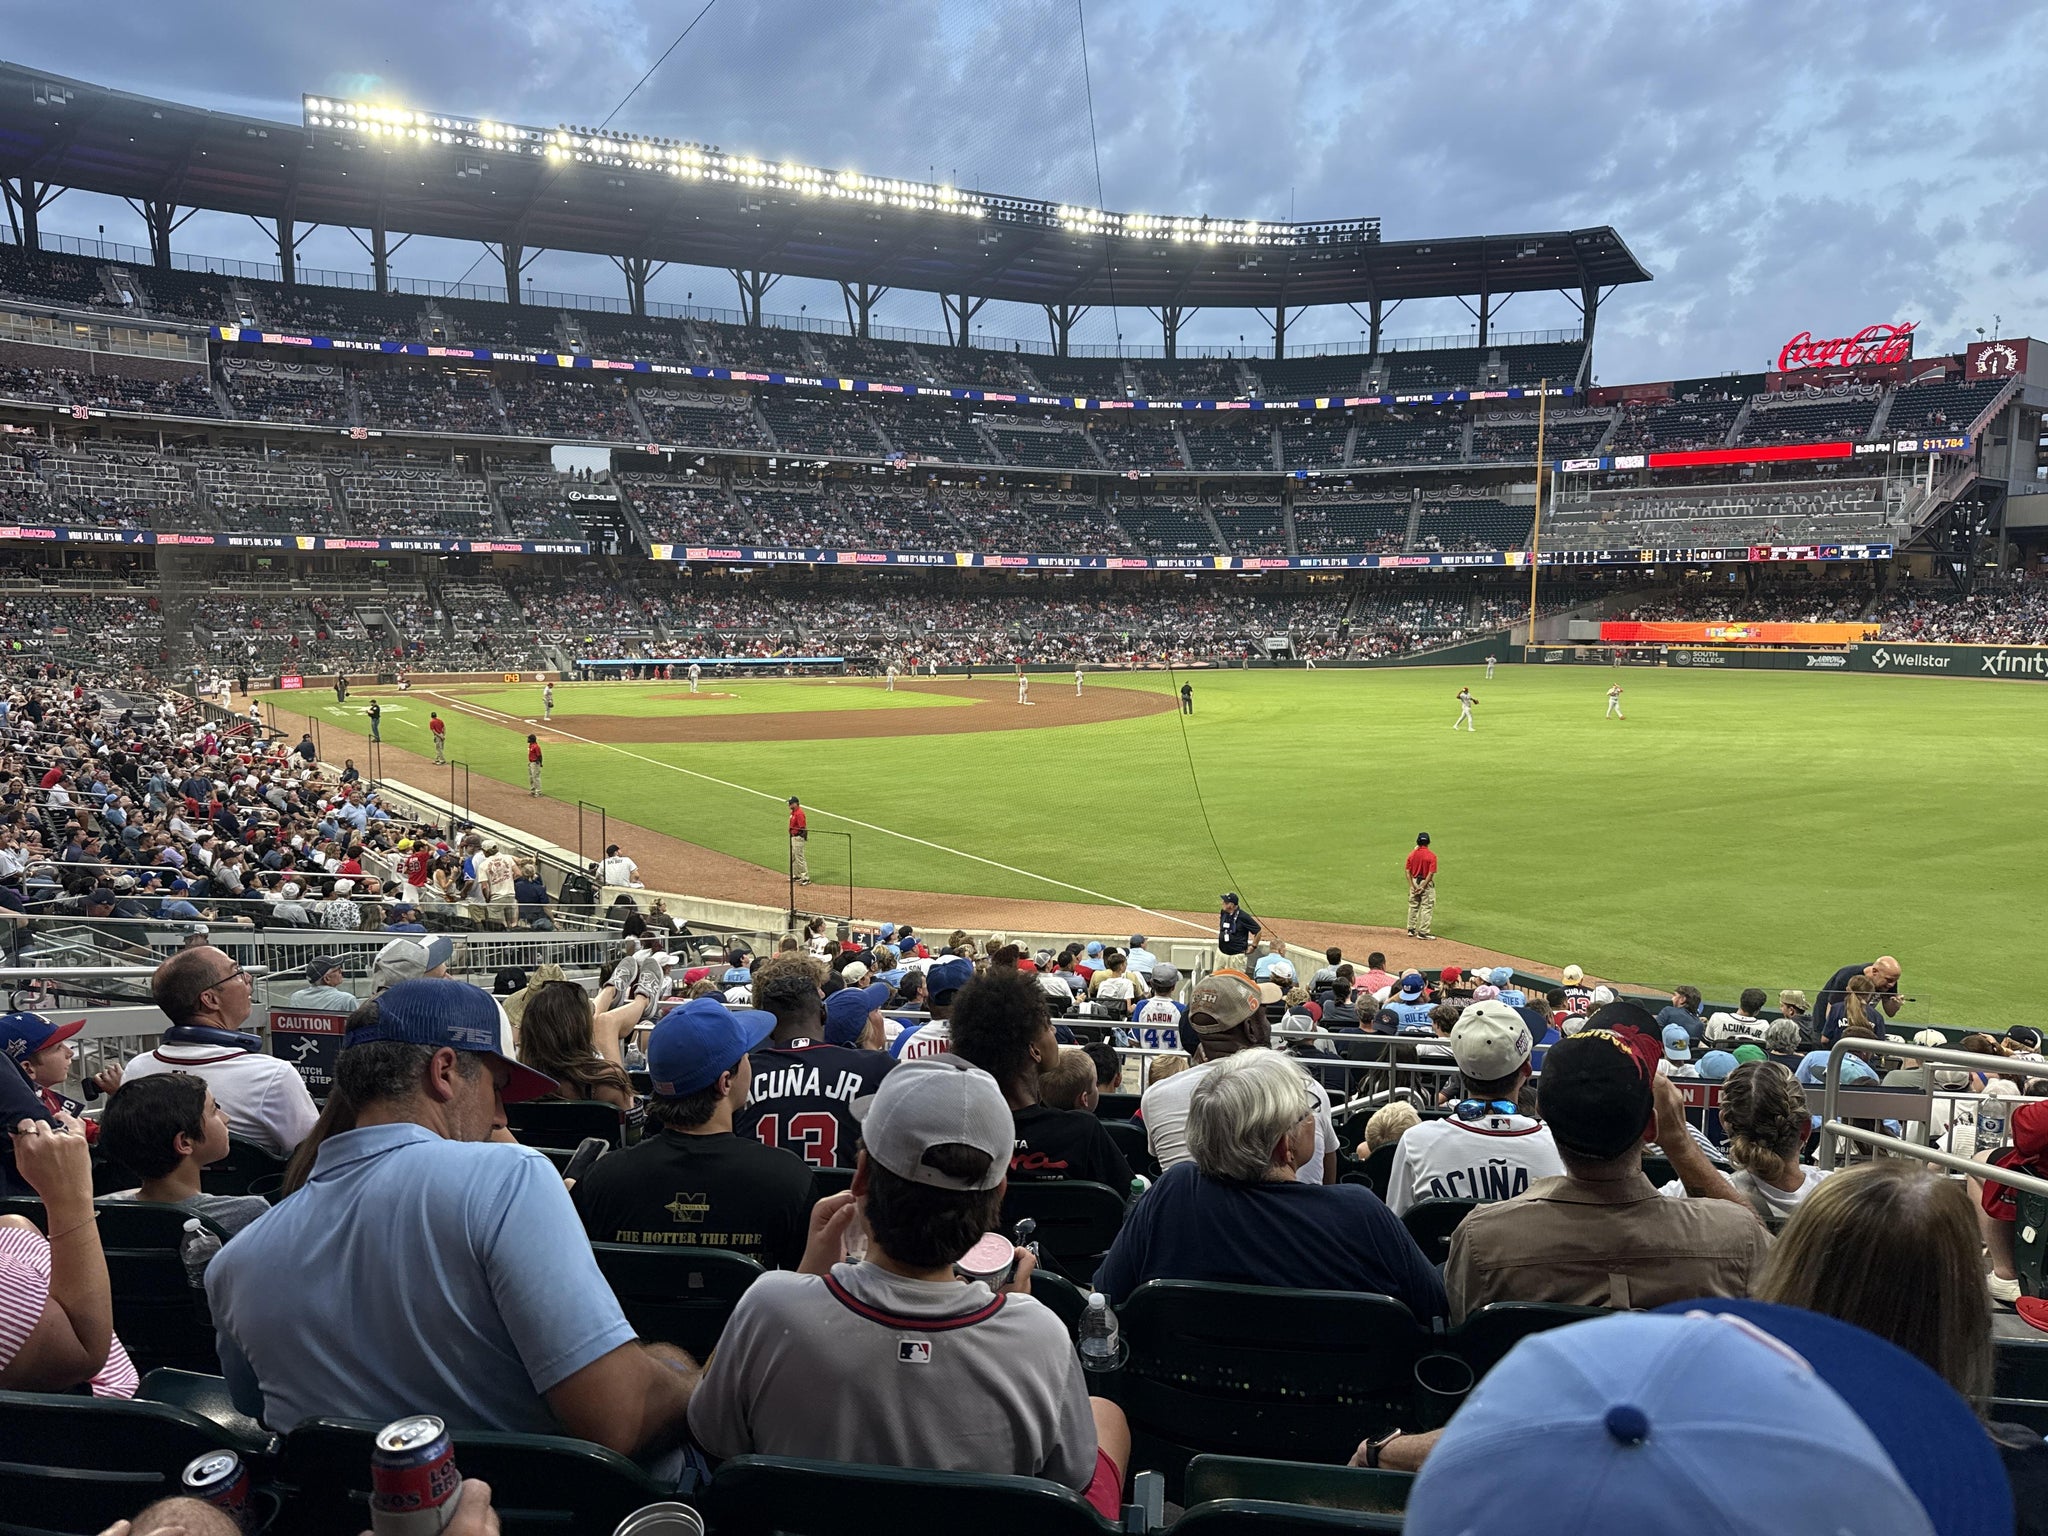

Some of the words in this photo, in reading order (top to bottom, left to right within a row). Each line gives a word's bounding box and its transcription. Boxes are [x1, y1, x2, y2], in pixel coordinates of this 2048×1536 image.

[72, 405, 89, 420] 31
[350, 427, 368, 440] 35
[1876, 443, 1890, 452] PM
[1922, 438, 1964, 450] $11,784
[894, 459, 907, 470] 44
[1689, 496, 1760, 516] AARON
[1767, 492, 1867, 514] TERRACE
[1893, 653, 1950, 668] Wellstar
[1567, 997, 1590, 1014] 13
[278, 1016, 332, 1031] CAUTION
[1146, 1014, 1172, 1023] AARON
[1404, 1012, 1428, 1023] RILEY
[448, 1026, 492, 1044] 715
[1144, 1029, 1176, 1048] 44
[1752, 1029, 1763, 1038] JR
[908, 1035, 950, 1060] ACUÑ
[310, 1076, 332, 1086] STEP
[825, 1070, 863, 1104] JR
[756, 1111, 838, 1168] 13
[1430, 1158, 1529, 1200] ACUÑA
[616, 1230, 640, 1243] THE
[642, 1231, 697, 1244] HOTTER
[700, 1232, 728, 1245] THE
[732, 1232, 762, 1245] FIRE
